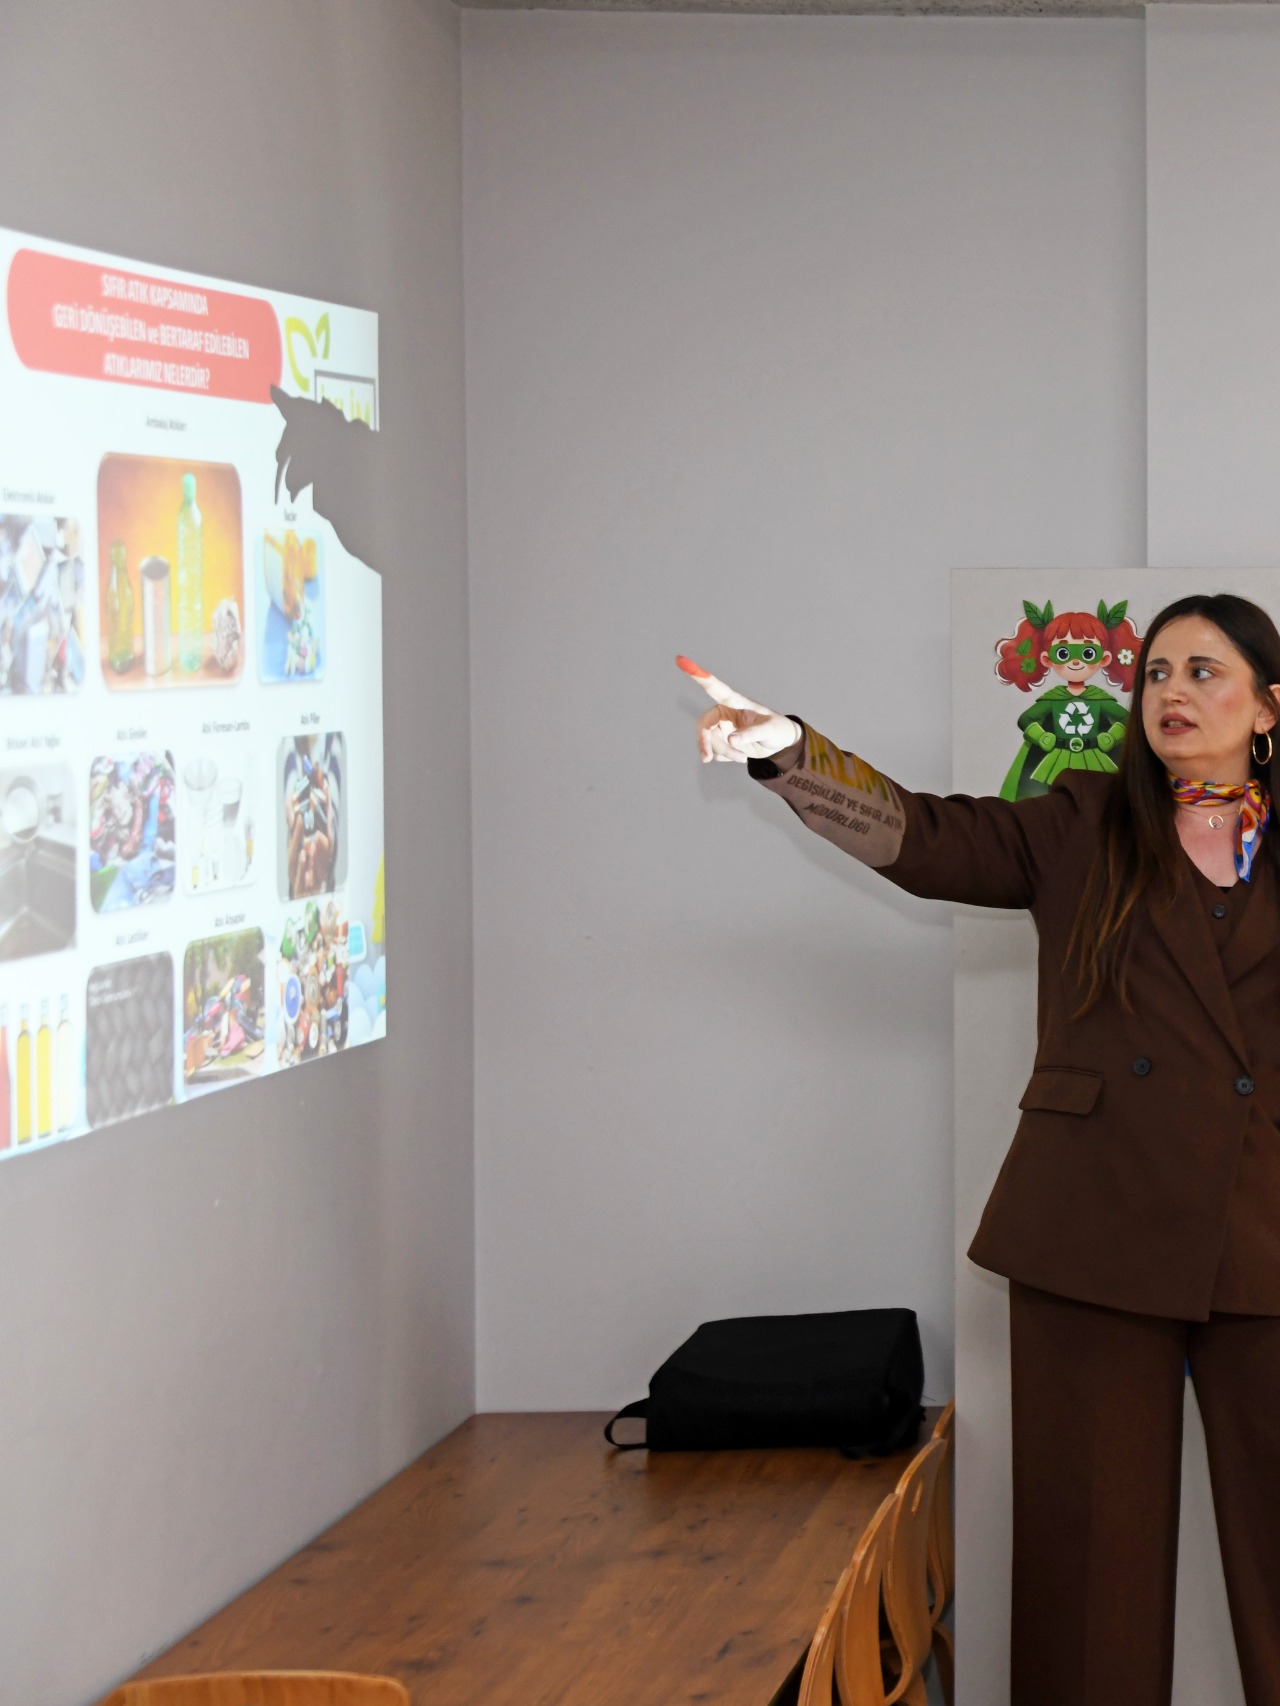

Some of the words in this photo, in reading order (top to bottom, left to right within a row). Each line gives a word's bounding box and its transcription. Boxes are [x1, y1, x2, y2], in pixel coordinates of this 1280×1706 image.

[150, 283, 208, 315] KAPSAMINDA
[53, 302, 79, 328] GERİ
[80, 304, 146, 342] DÖNÜŞEBİLEN
[159, 323, 203, 351] BERTARAF
[205, 329, 249, 359] EDİLEBİLEN
[103, 353, 162, 382] ATIKLARIMIZ
[163, 362, 210, 389] NELERDİR?
[803, 802, 870, 835] MÜDÜRLÜĞÜ
[847, 797, 857, 812] VE
[859, 803, 882, 821] SIFIR
